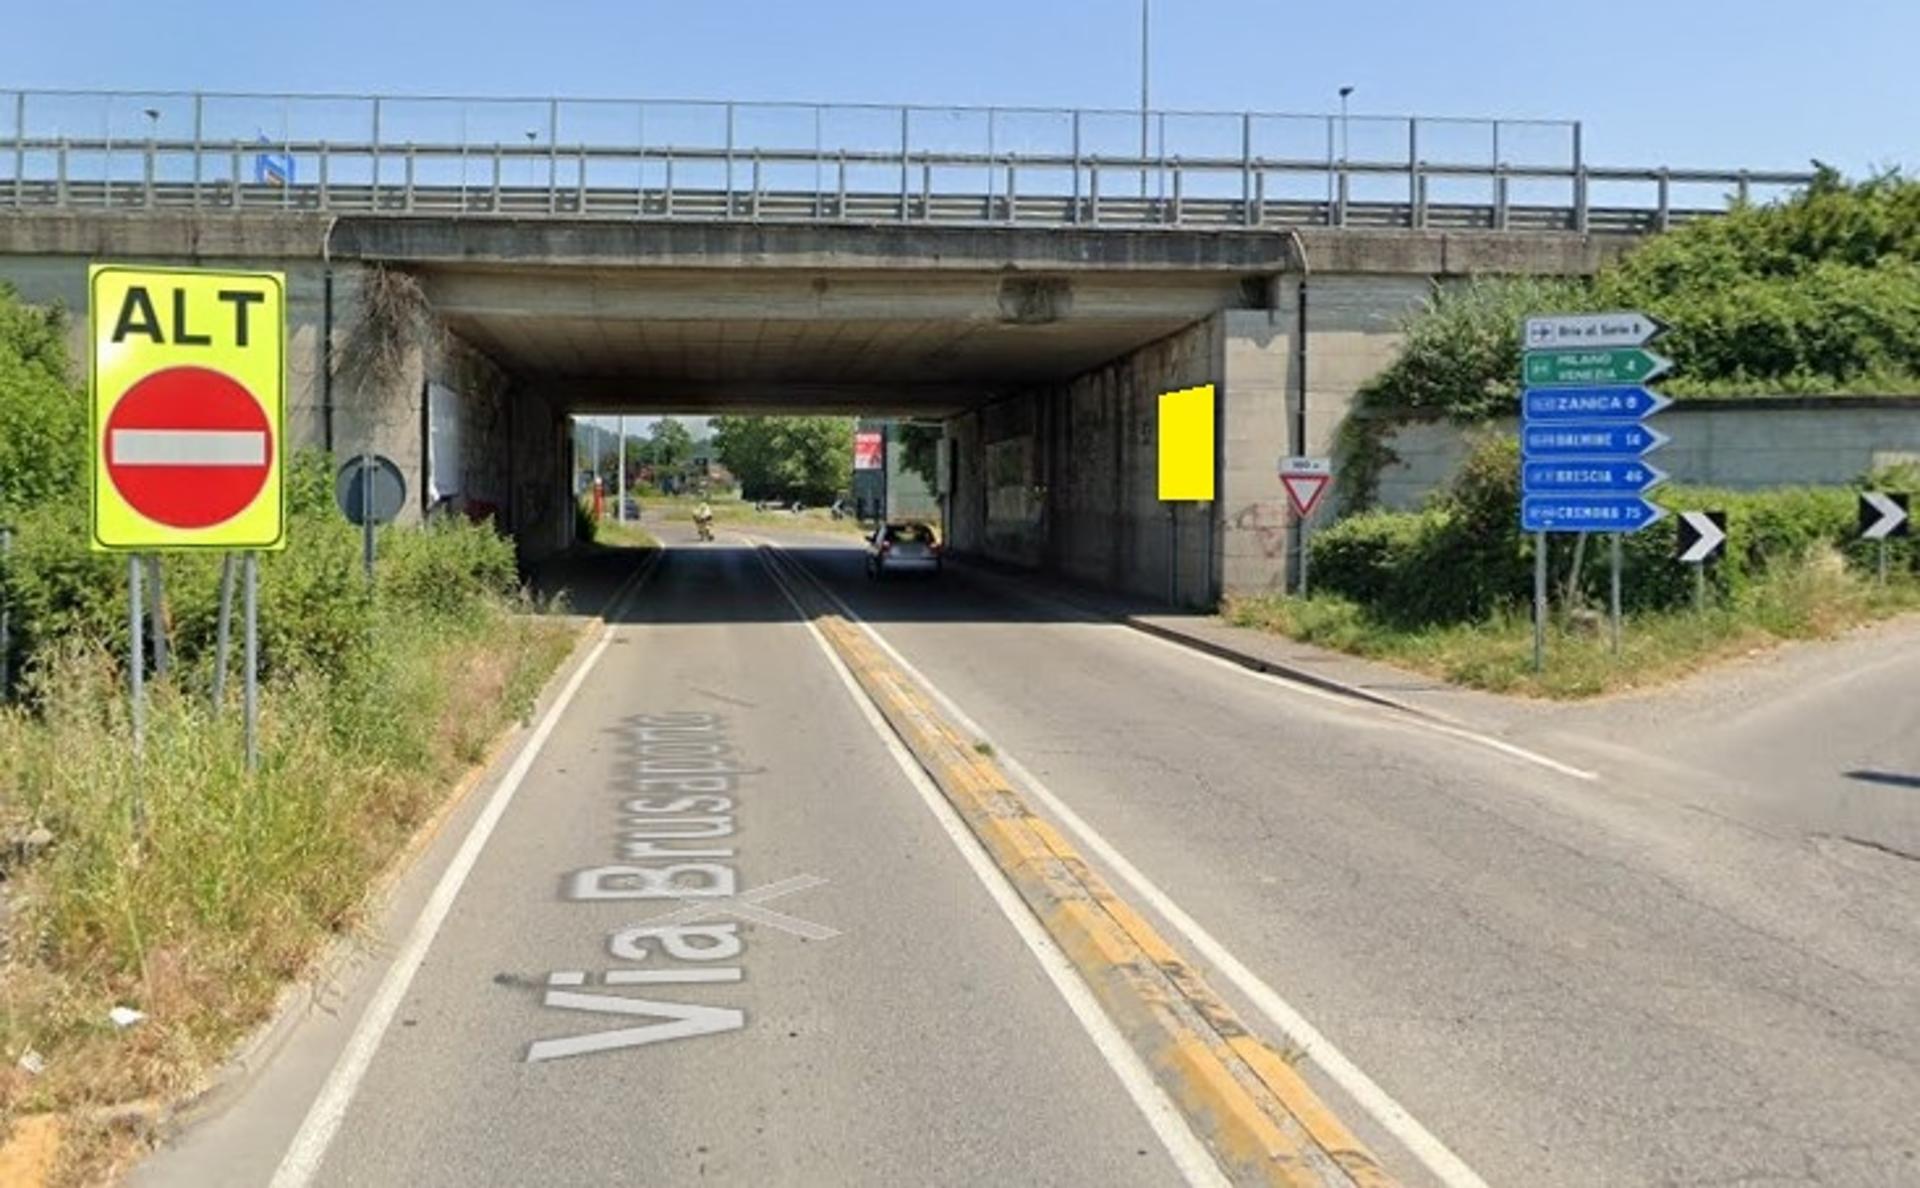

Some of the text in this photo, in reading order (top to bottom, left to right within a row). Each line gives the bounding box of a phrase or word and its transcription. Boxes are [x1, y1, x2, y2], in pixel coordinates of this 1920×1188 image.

[111, 286, 265, 347] ALT
[1557, 353, 1613, 366] MILANO
[1557, 396, 1622, 411] ZANICA
[1556, 469, 1613, 483] BRESCIA
